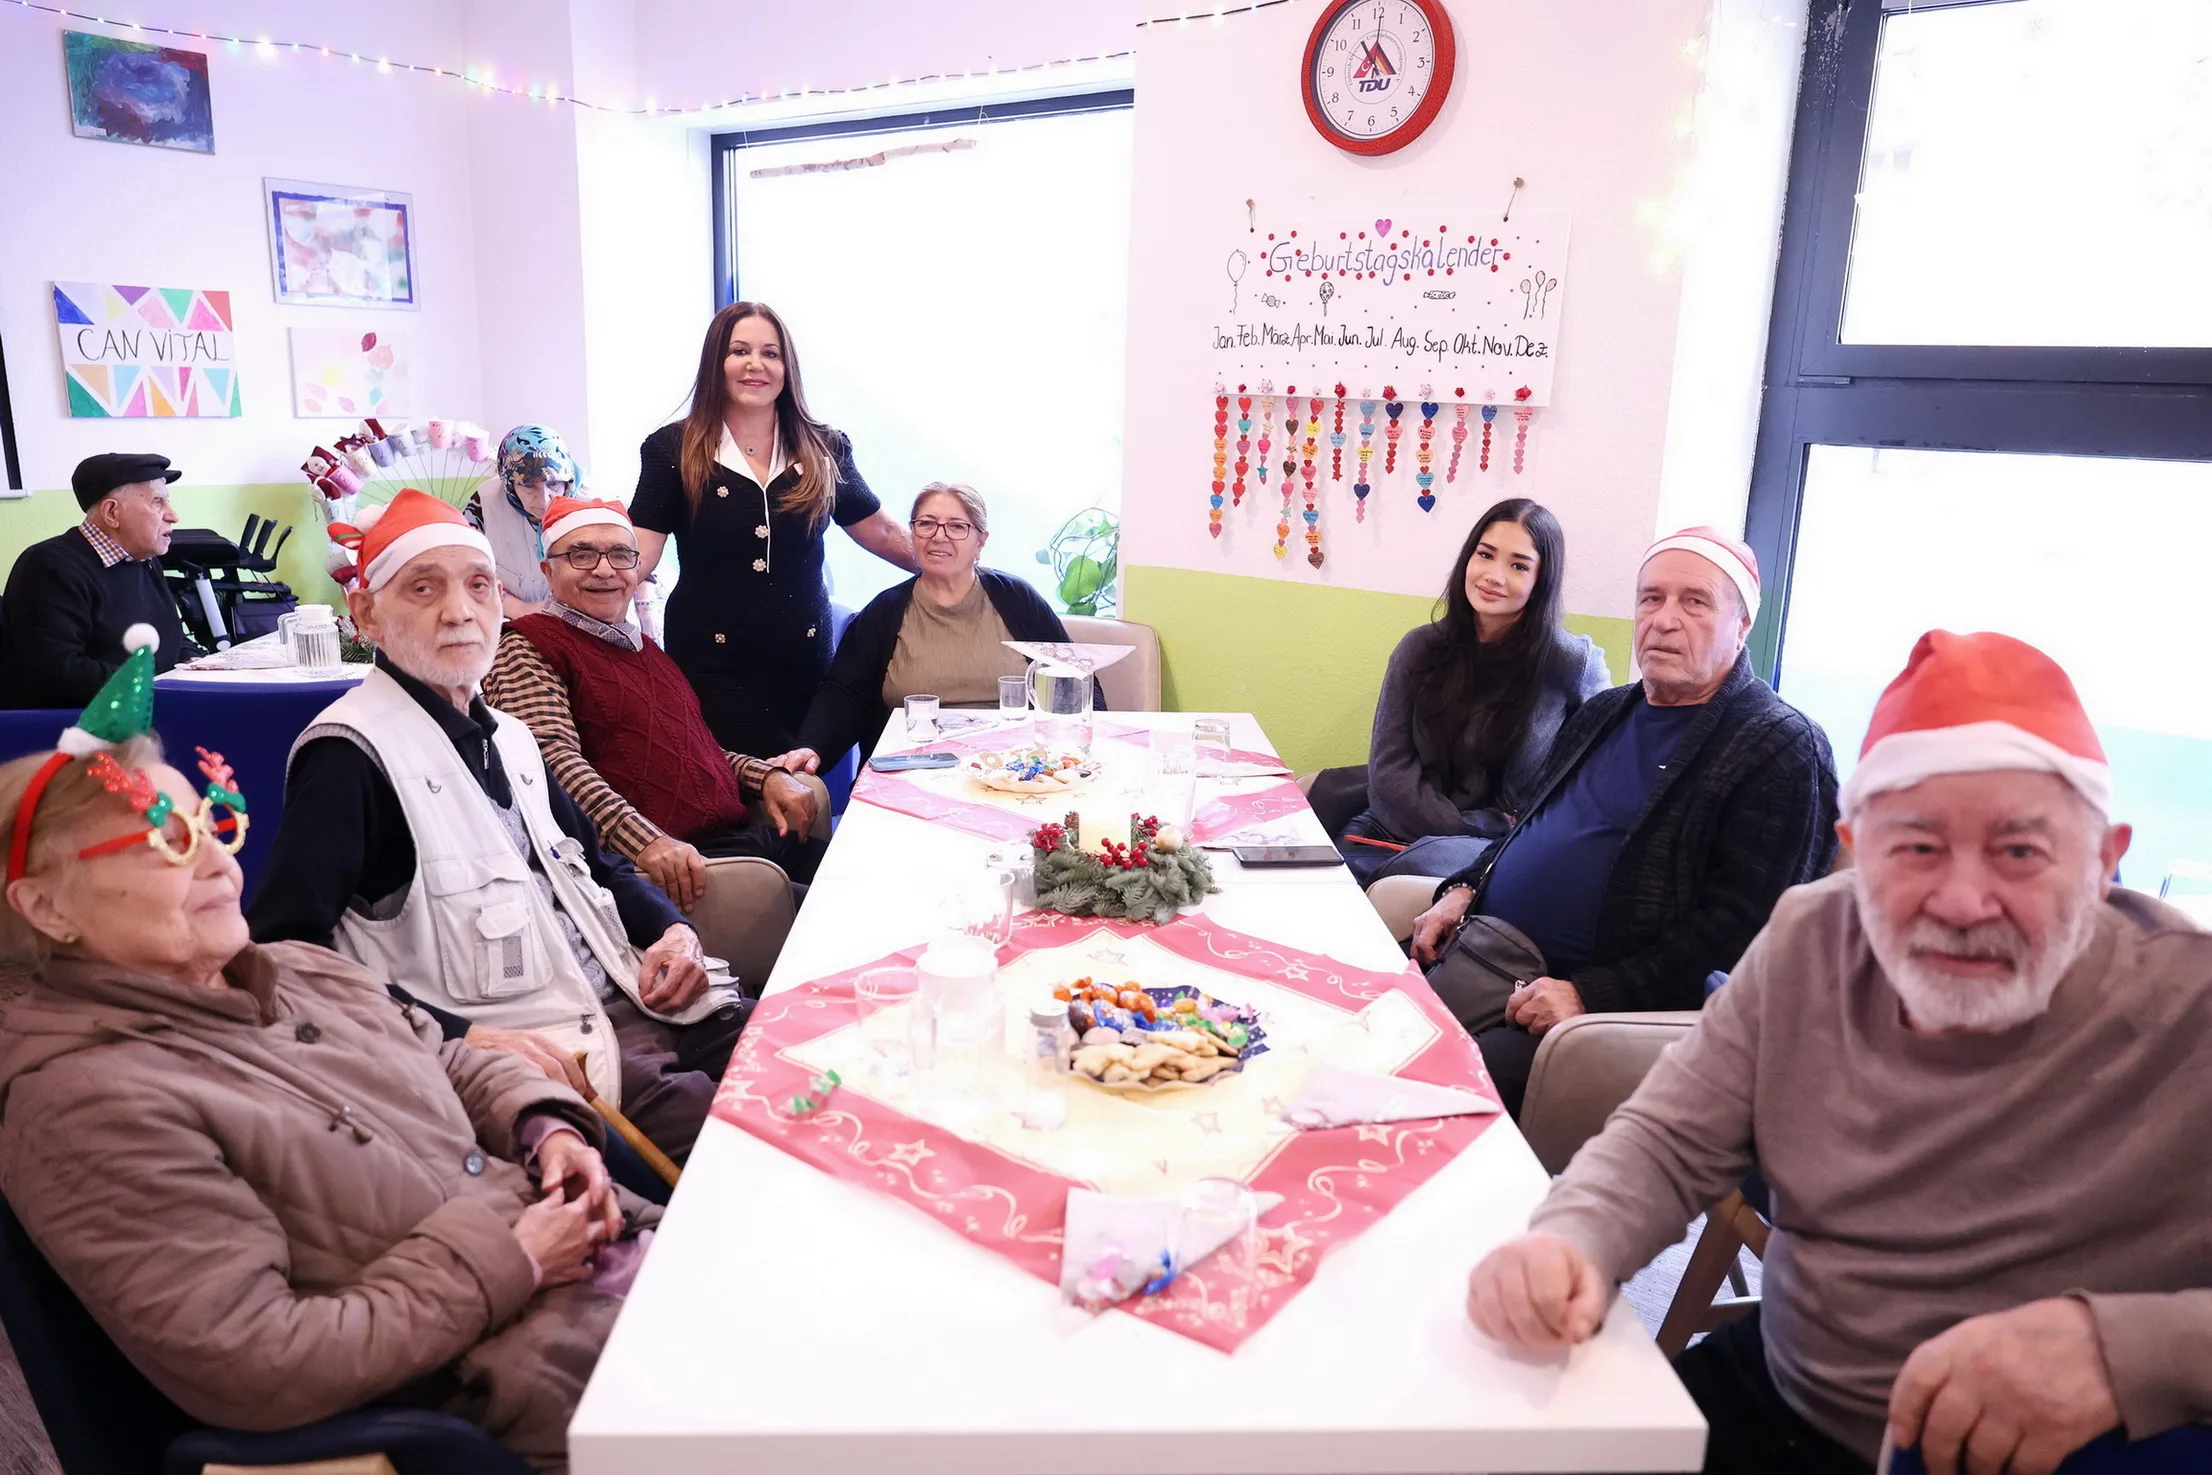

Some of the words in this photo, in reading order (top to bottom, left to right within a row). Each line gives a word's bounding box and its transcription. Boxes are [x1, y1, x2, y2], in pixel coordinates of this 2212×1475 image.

[1372, 7, 1385, 20] 12
[1398, 13, 1404, 25] 1
[1351, 19, 1361, 30] 11
[1412, 31, 1420, 43] 2
[1334, 39, 1347, 51] 10
[1416, 57, 1426, 68] 3
[1326, 67, 1335, 77] 9
[1358, 77, 1391, 93] TDU
[1408, 85, 1415, 96] 4
[1331, 92, 1339, 103] 8
[1347, 110, 1354, 121] 7
[1390, 106, 1398, 117] 5
[1367, 115, 1376, 126] 6
[1269, 235, 1503, 286] Geburtstagskalender
[77, 328, 142, 361] CAN
[1212, 326, 1236, 349] Jan.
[1237, 324, 1260, 347] Feb.
[1291, 322, 1313, 352] Apr.
[1338, 324, 1362, 347] Jun.
[1365, 326, 1387, 349] Jul.
[1391, 326, 1419, 356] Aug.
[1453, 333, 1481, 355] Okt.
[1482, 335, 1513, 356] Nov.
